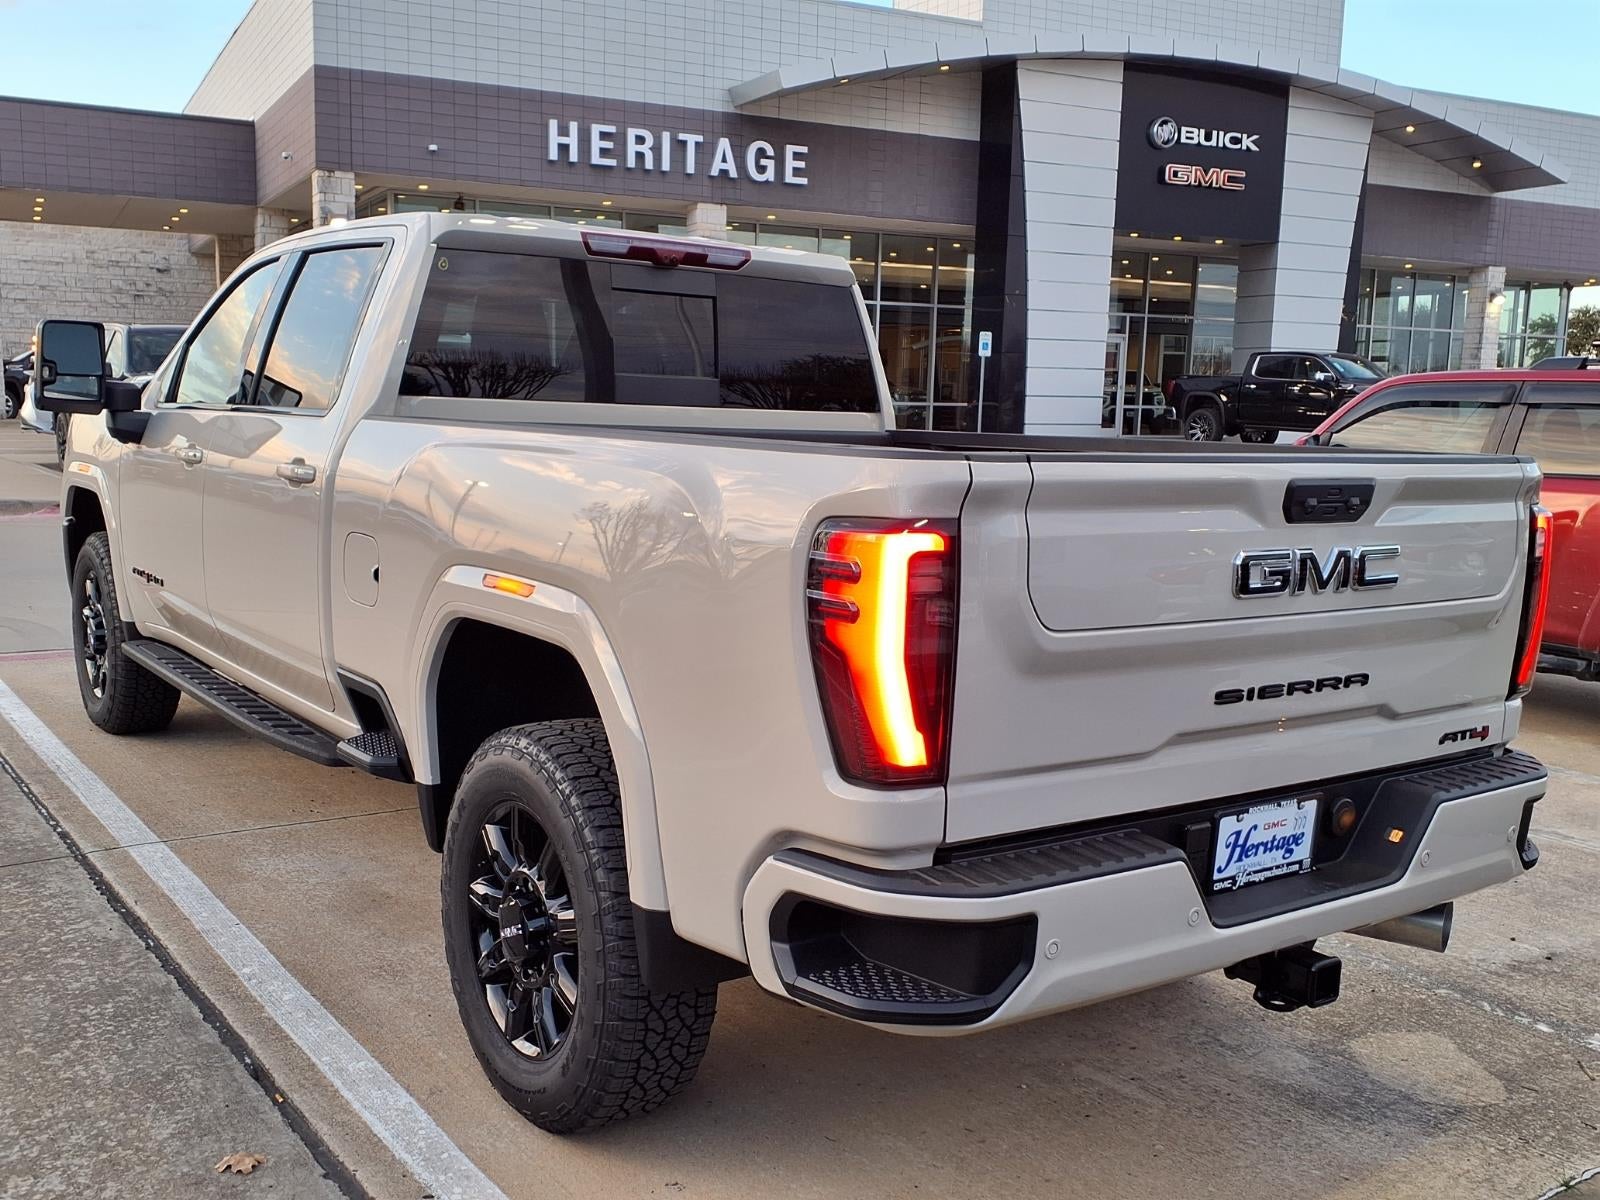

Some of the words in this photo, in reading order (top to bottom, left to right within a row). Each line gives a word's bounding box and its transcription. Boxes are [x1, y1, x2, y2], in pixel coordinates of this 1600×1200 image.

[548, 118, 809, 186] HERITAGE
[1180, 126, 1260, 151] BUICK
[1165, 163, 1246, 190] GMC
[1231, 544, 1400, 599] GMC
[1214, 672, 1370, 705] SIERRA
[1438, 725, 1490, 745] AT4
[1263, 819, 1288, 830] GMC
[1216, 824, 1305, 874] Heritage
[1213, 880, 1233, 891] GMC
